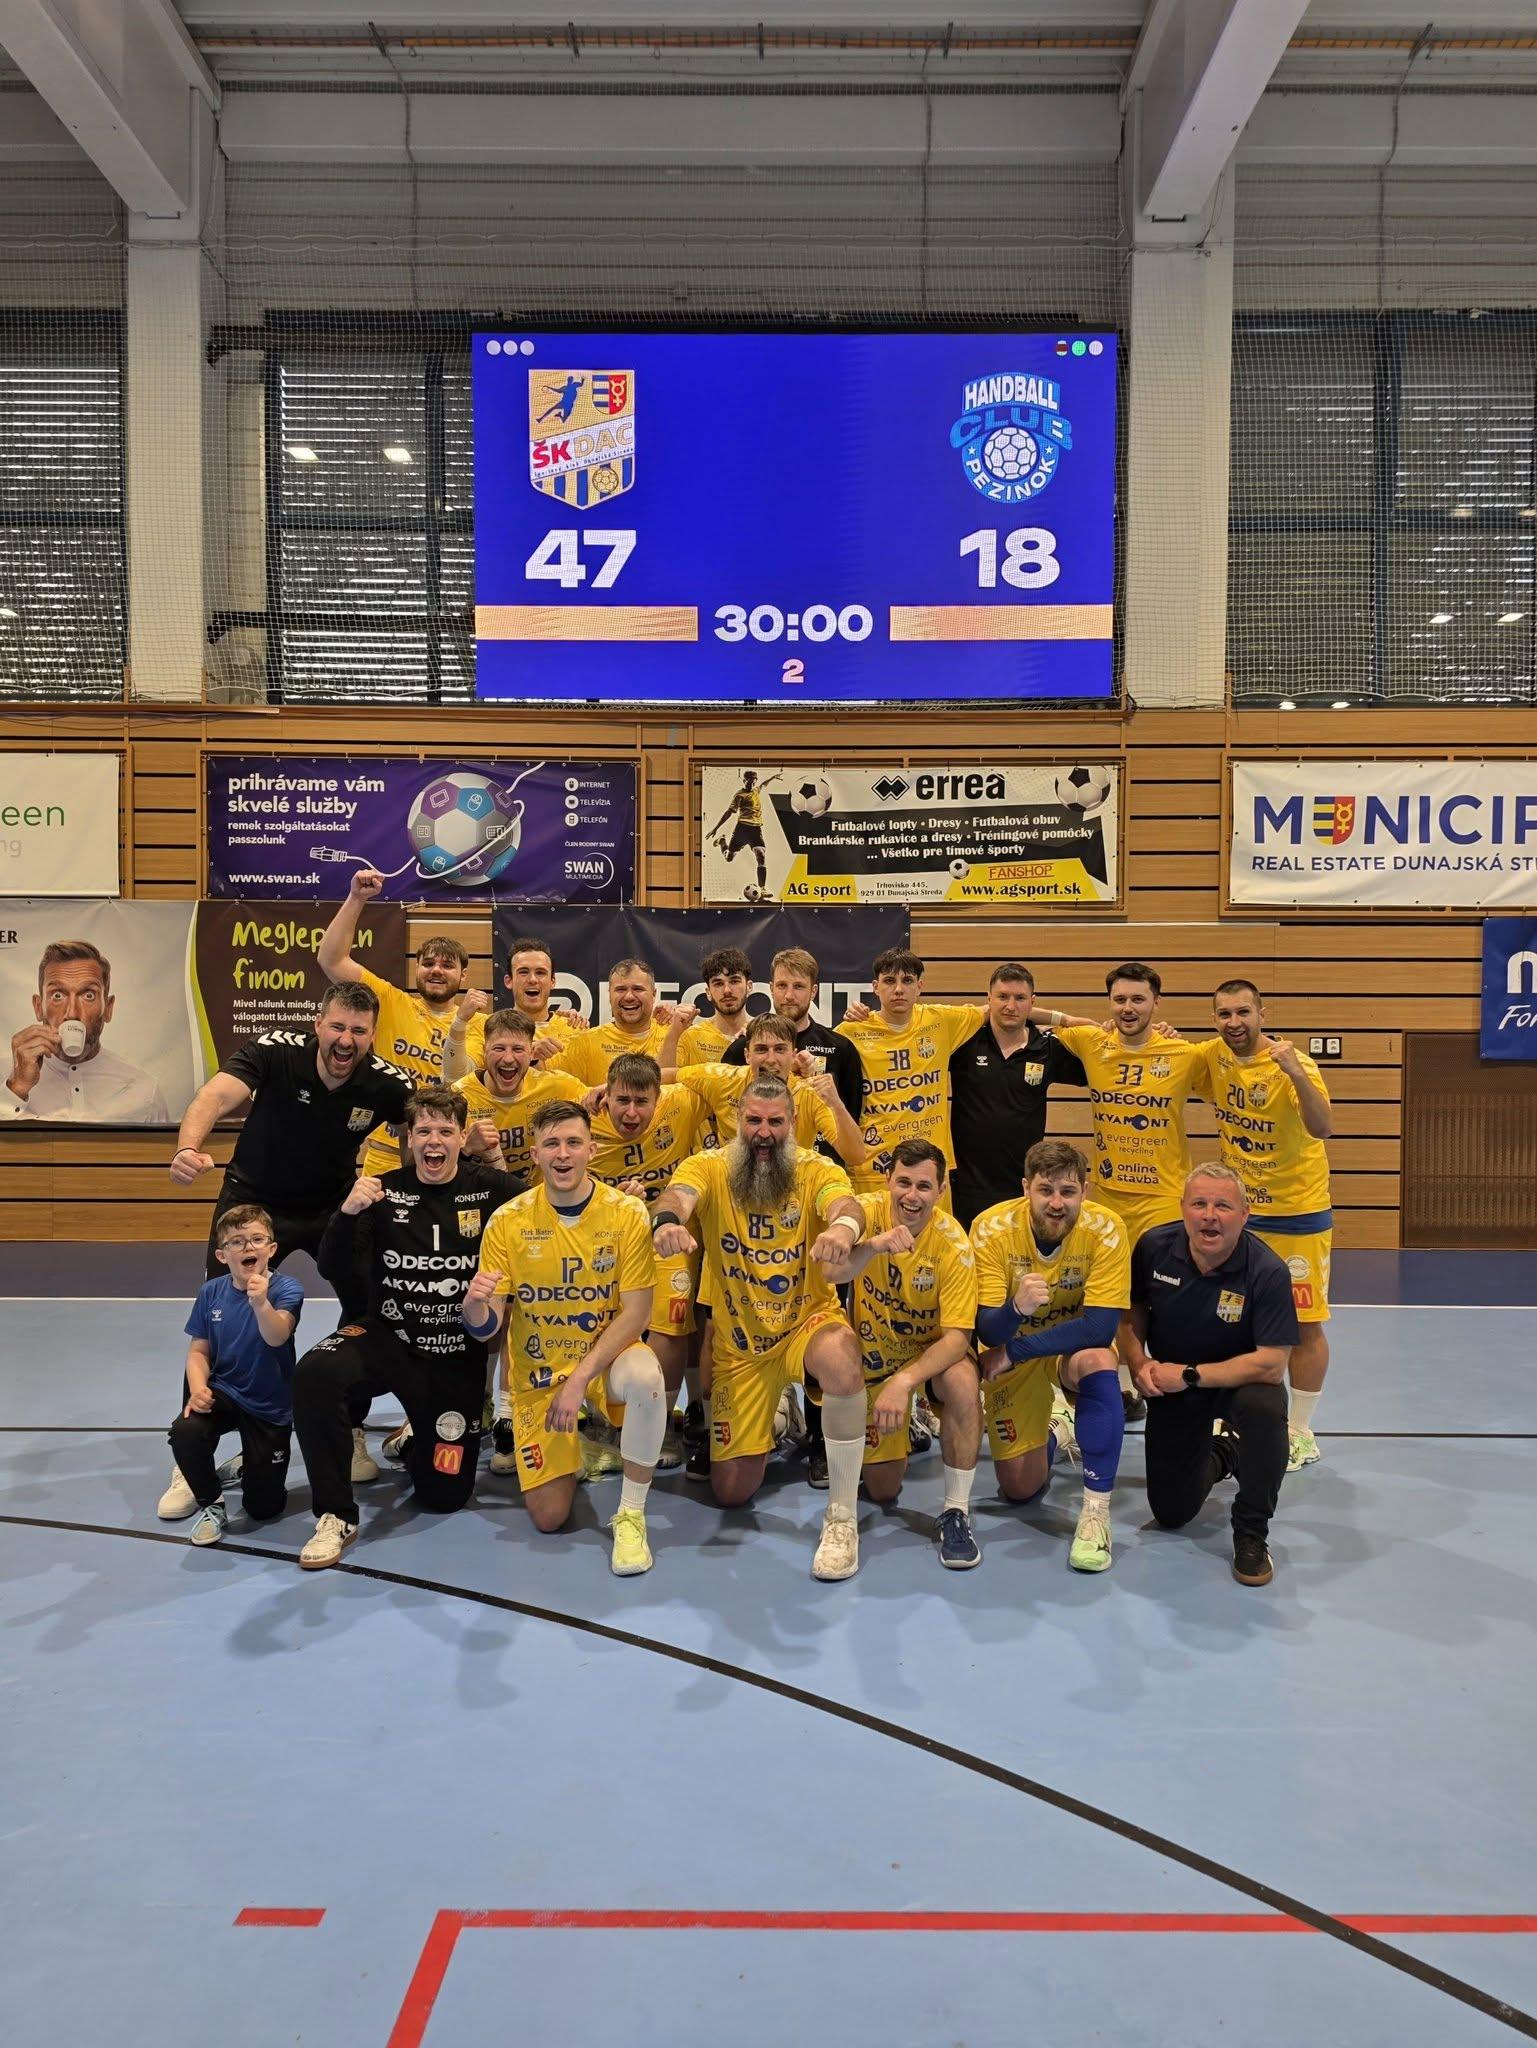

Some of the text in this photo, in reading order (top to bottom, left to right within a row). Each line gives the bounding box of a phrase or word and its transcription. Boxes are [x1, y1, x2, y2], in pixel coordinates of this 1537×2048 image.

[965, 376, 1058, 411] HANDBALL
[950, 406, 1073, 451] CLUB
[531, 422, 633, 469] ŠK DAC
[966, 455, 1056, 500] PEZINOK
[525, 529, 637, 588] 47
[960, 527, 1060, 589] 18
[714, 604, 873, 643] 30:00
[782, 659, 805, 684] 2
[228, 773, 385, 794] prihrávame vám
[580, 781, 610, 789] INTERNET
[228, 795, 357, 818] skvelé služby
[228, 820, 350, 833] remek szolgáltatásokat
[831, 815, 1061, 832] Futbalové lopty Dresy Futbalová obuv
[228, 835, 286, 846] passzolunk
[798, 833, 865, 846] Brankárske
[868, 834, 918, 845] rukavice
[931, 831, 963, 842] dresy
[973, 829, 1039, 842] Tréningové
[1042, 827, 1094, 841] pomôcky
[881, 847, 920, 859] Všetko
[923, 848, 942, 859] pre
[945, 846, 984, 856] tímové
[987, 844, 1025, 856] športy
[564, 861, 604, 874] SWAN
[1252, 856, 1304, 871] REAL
[1311, 856, 1386, 871] ESTATE
[1393, 853, 1503, 871] DUNAJSKÁ
[228, 873, 321, 884] www.swan.sk
[989, 866, 1052, 879] FANSHOP
[787, 883, 851, 898] AG sport
[961, 882, 1081, 898] www.agsport.sk
[232, 957, 305, 990] finom
[232, 1000, 257, 1008] Mivel
[258, 1000, 286, 1009] nálunk
[287, 1001, 316, 1010] mindig
[232, 1013, 276, 1023] válogatott
[232, 1025, 251, 1034] friss
[805, 1046, 836, 1054] KONSTAT
[886, 1049, 911, 1072] 38
[874, 1070, 941, 1093] DECONT
[1115, 1064, 1143, 1086] 33
[1102, 1092, 1172, 1108] DECONT
[1227, 1083, 1245, 1109] 20
[883, 1115, 943, 1132] evergreen
[1106, 1133, 1168, 1146] evergreen
[623, 1143, 644, 1167] 21
[1118, 1147, 1154, 1156] recycling
[1117, 1163, 1157, 1173] online
[1116, 1174, 1159, 1184] stavba
[385, 1189, 401, 1199] Park
[455, 1191, 490, 1203] KONSTAT
[749, 1213, 775, 1240] 85
[432, 1224, 440, 1251] 1
[402, 1255, 479, 1270] DECON
[1153, 1270, 1180, 1287] hummel
[416, 1333, 465, 1345] online
